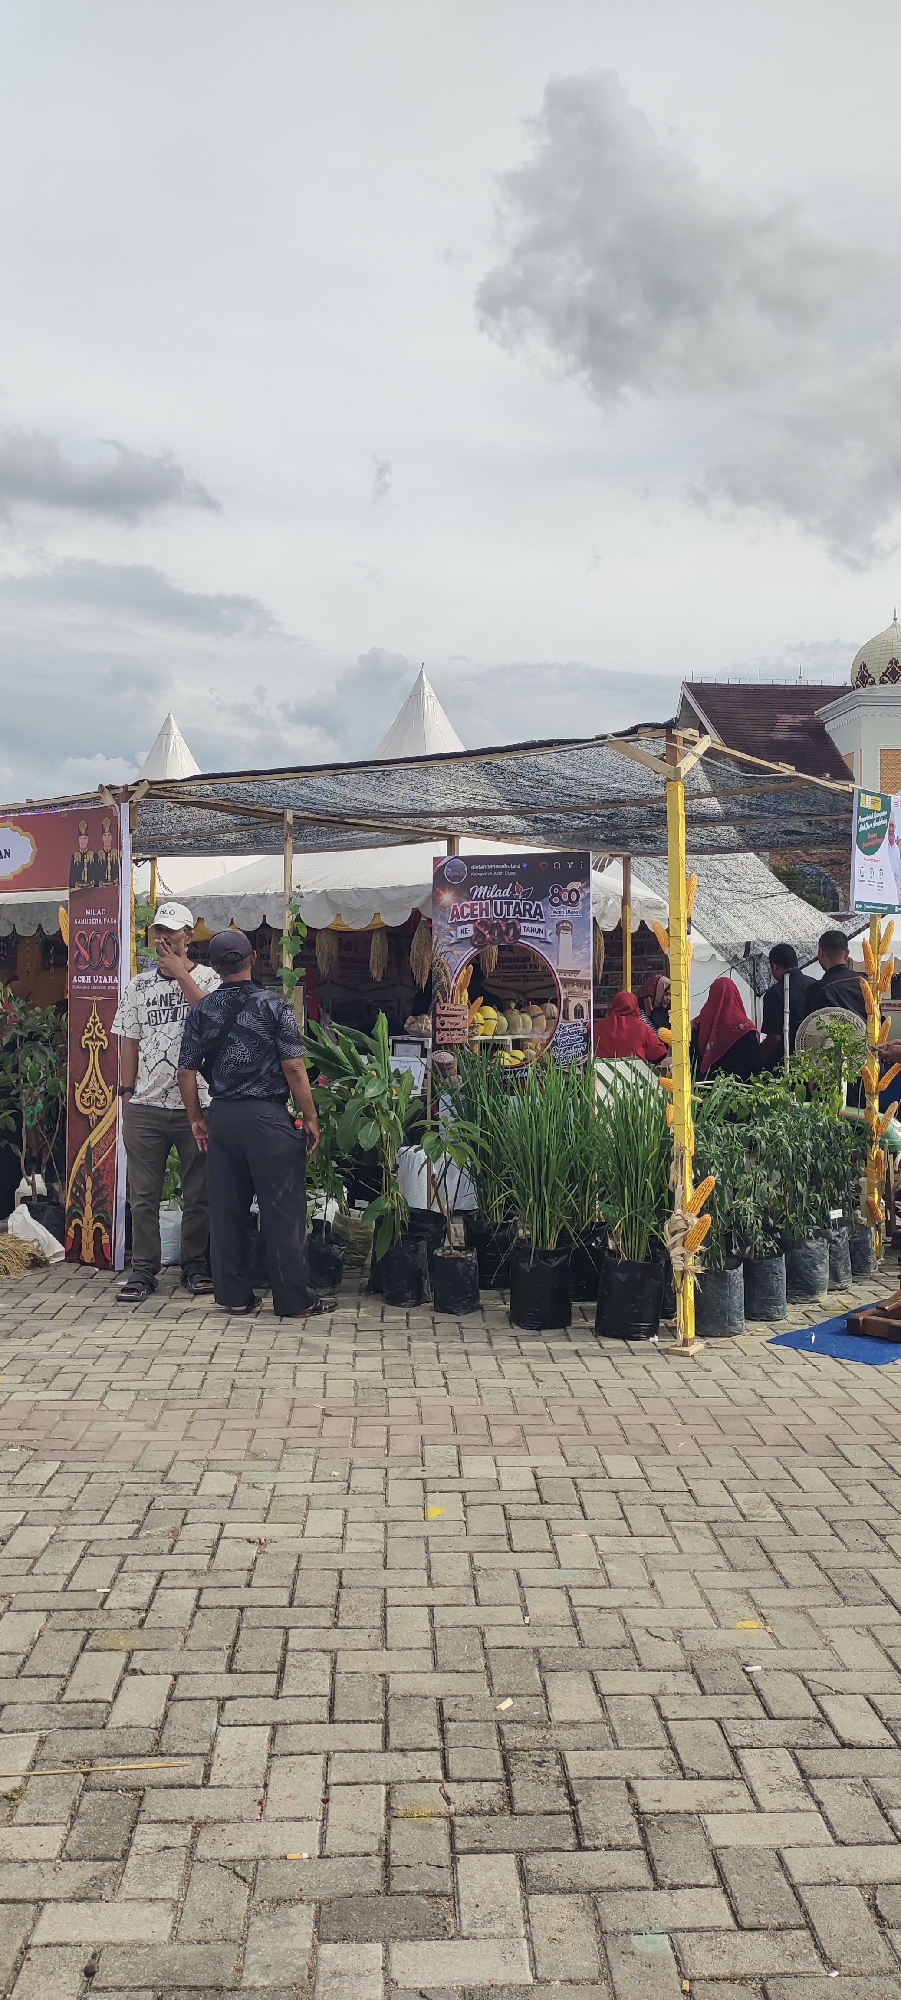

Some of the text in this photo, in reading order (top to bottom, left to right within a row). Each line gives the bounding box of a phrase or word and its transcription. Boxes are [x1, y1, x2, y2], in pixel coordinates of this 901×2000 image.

[469, 882, 512, 900] Milad
[549, 884, 581, 907] 800
[449, 900, 545, 922] ACEH UTARA
[470, 918, 521, 947] 800
[522, 925, 544, 935] TAHUN
[73, 930, 119, 971] 800
[72, 975, 119, 984] ACEH UTARA
[149, 1009, 173, 1026] GIVE
